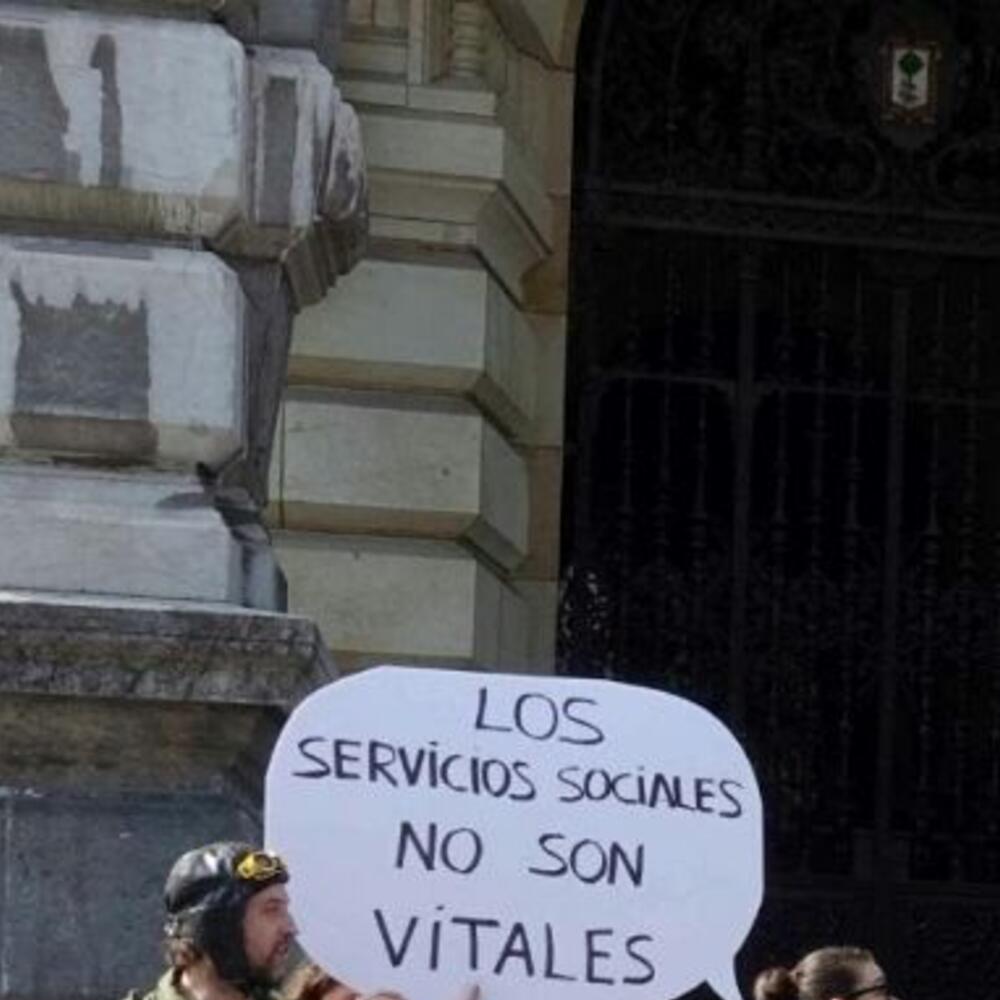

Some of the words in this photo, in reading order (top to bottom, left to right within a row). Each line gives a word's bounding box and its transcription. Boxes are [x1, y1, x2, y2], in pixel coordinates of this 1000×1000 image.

[474, 687, 606, 745] LOS
[395, 821, 484, 875] NO
[528, 833, 645, 888] SON
